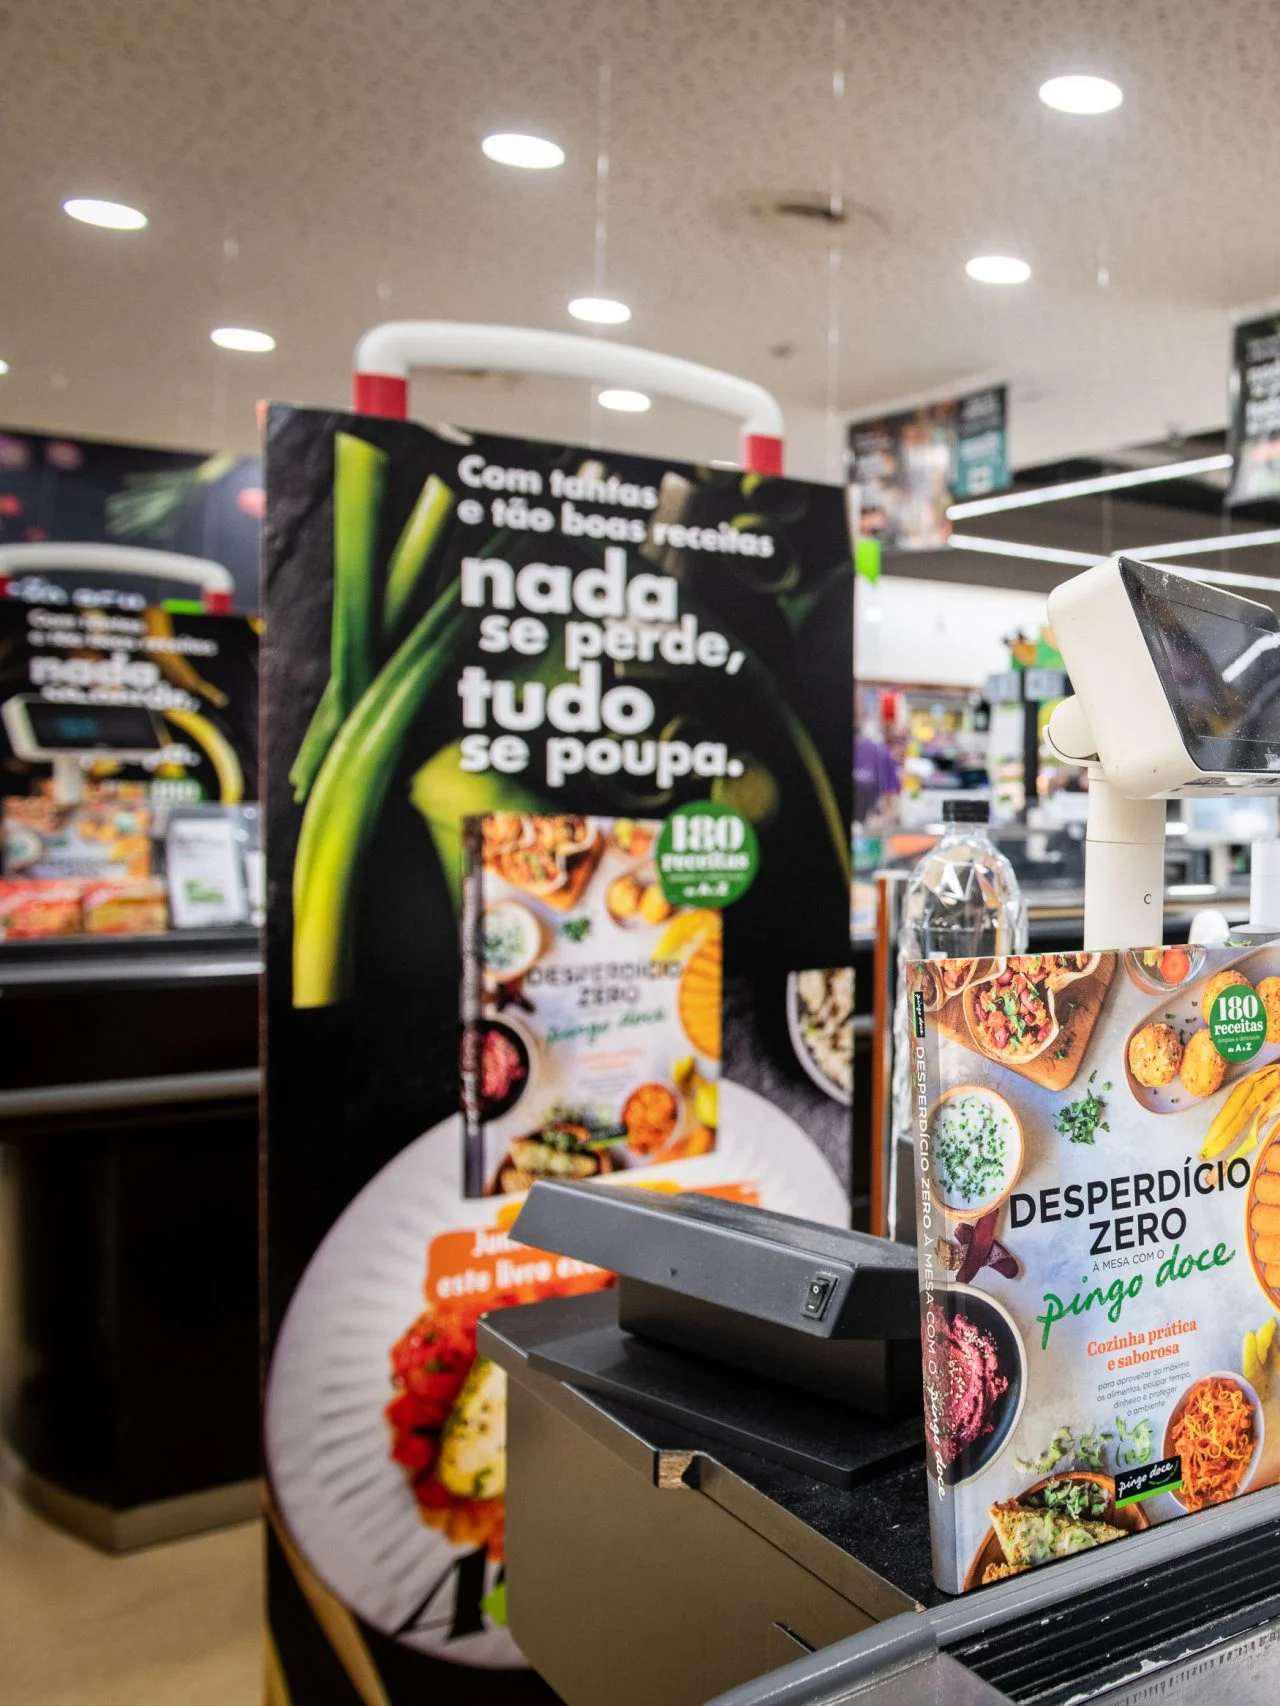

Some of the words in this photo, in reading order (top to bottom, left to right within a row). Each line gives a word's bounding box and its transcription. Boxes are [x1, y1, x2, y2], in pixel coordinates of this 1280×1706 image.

[458, 454, 543, 494] Com
[550, 468, 659, 510] tantas
[457, 499, 484, 525] e
[491, 496, 555, 533] tão
[561, 501, 647, 544] boas
[653, 521, 776, 558] receitas
[461, 546, 679, 622] nada
[478, 614, 549, 655] se
[565, 613, 746, 676] perde,
[458, 660, 656, 736] tudo
[459, 733, 531, 774] se
[546, 736, 745, 790] poupa.
[671, 814, 745, 853] 180
[1214, 1018, 1264, 1036] receitas
[1217, 994, 1258, 1021] 180
[1235, 1043, 1242, 1053] A
[1246, 1042, 1252, 1051] Z
[916, 1046, 931, 1171] DESPERDÍCIO
[921, 1177, 932, 1230] ZERO
[1010, 1157, 1250, 1229] DESPERDÍCIO
[923, 1233, 934, 1246] À
[1089, 1207, 1187, 1256] ZERO
[436, 1269, 491, 1299] este
[496, 1259, 551, 1290] livro
[924, 1253, 934, 1305] MESA
[1092, 1260, 1101, 1273] À
[1102, 1255, 1130, 1271] MESA
[1132, 1251, 1155, 1265] COM
[1156, 1249, 1165, 1260] O
[1036, 1275, 1143, 1350] pingo
[1155, 1242, 1236, 1288] doce
[926, 1311, 937, 1355] COM
[1087, 1331, 1146, 1357] Cozinha
[1148, 1318, 1198, 1347] prática
[928, 1360, 937, 1375] O
[1098, 1380, 1115, 1392] para
[1116, 1370, 1151, 1386] aproveitar
[1152, 1368, 1162, 1376] ao
[1163, 1359, 1190, 1373] máximo
[1107, 1358, 1116, 1371] e
[1117, 1341, 1180, 1370] saborosa
[1113, 1395, 1142, 1409] dinheiro
[1148, 1385, 1177, 1401] proteger
[1143, 1377, 1167, 1391] poupar
[927, 1385, 941, 1446] pingo
[1133, 1399, 1166, 1415] ambiente
[935, 1451, 947, 1502] doce
[1118, 1474, 1147, 1498] pingo
[1149, 1462, 1174, 1479] doce
